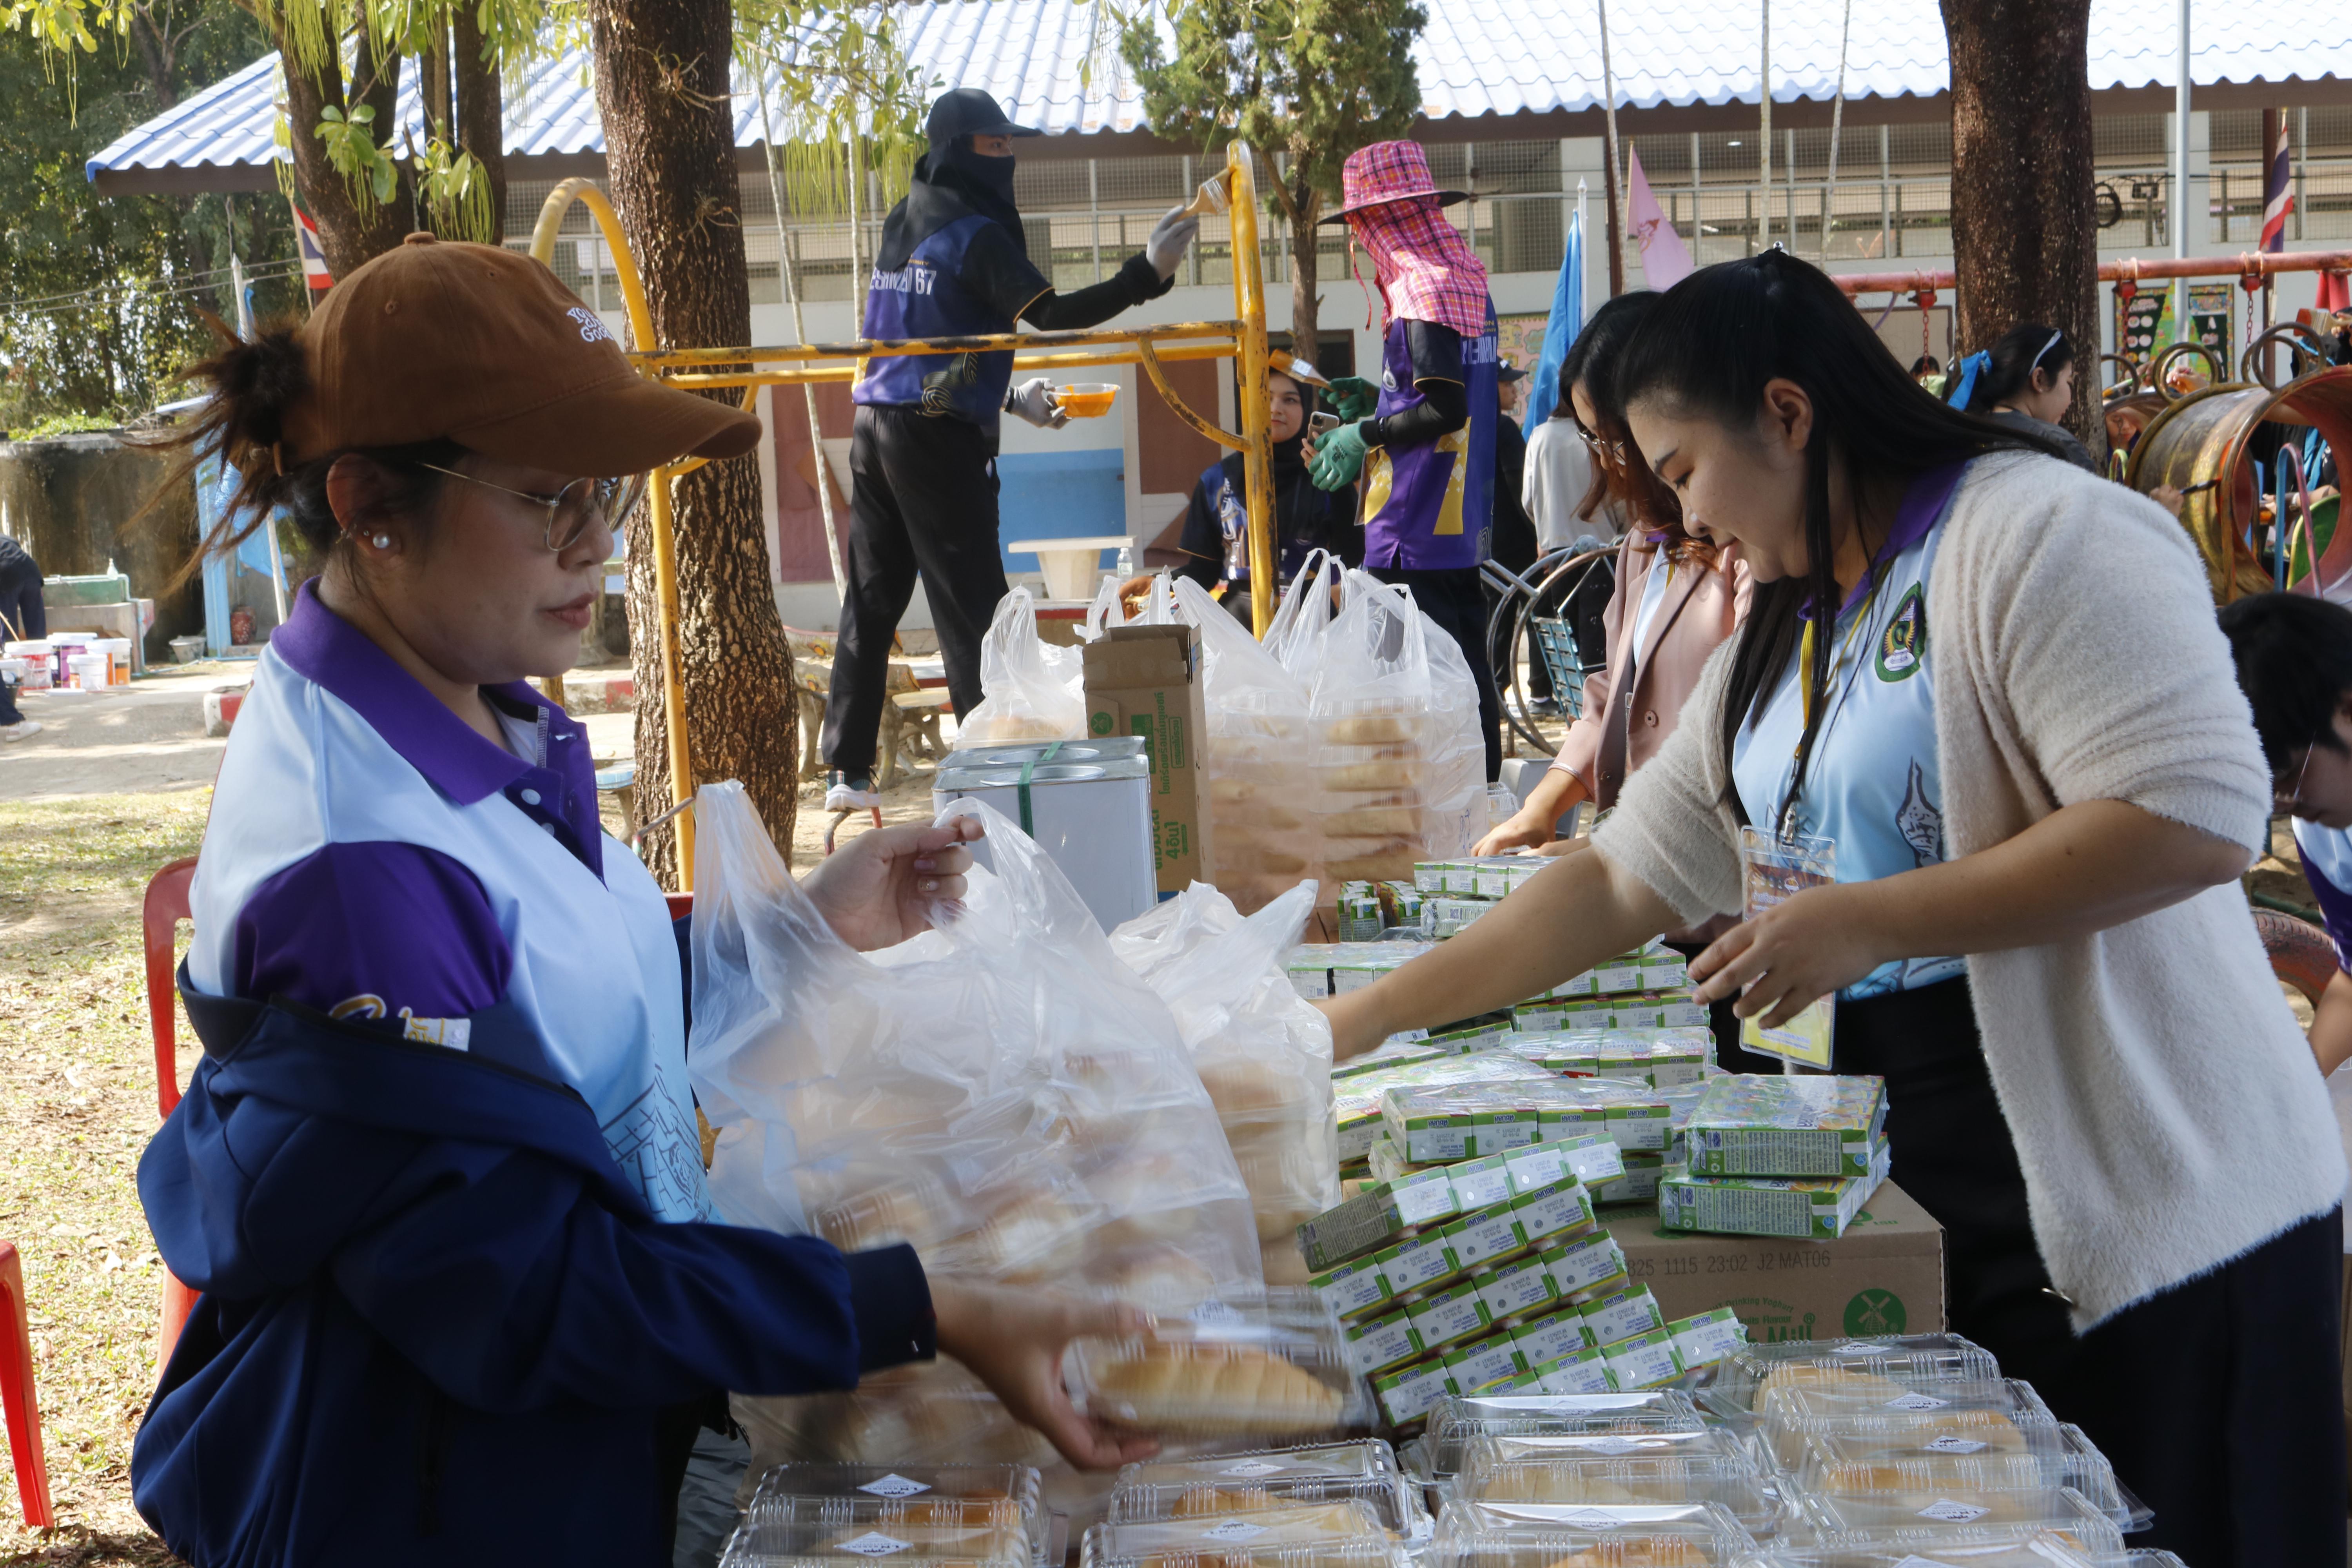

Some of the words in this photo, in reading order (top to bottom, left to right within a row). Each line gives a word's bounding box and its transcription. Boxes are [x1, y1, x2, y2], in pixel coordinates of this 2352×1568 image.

[916, 268, 936, 295] 67
[1665, 1257, 1698, 1275] 1115
[1707, 1255, 1748, 1273] 23:02
[1757, 1253, 1774, 1270] J2
[1779, 1250, 1831, 1269] MAT06
[1726, 1298, 1760, 1307] Drinking
[1763, 1298, 1794, 1312] Yoghurt
[1739, 1316, 1759, 1325] ruits
